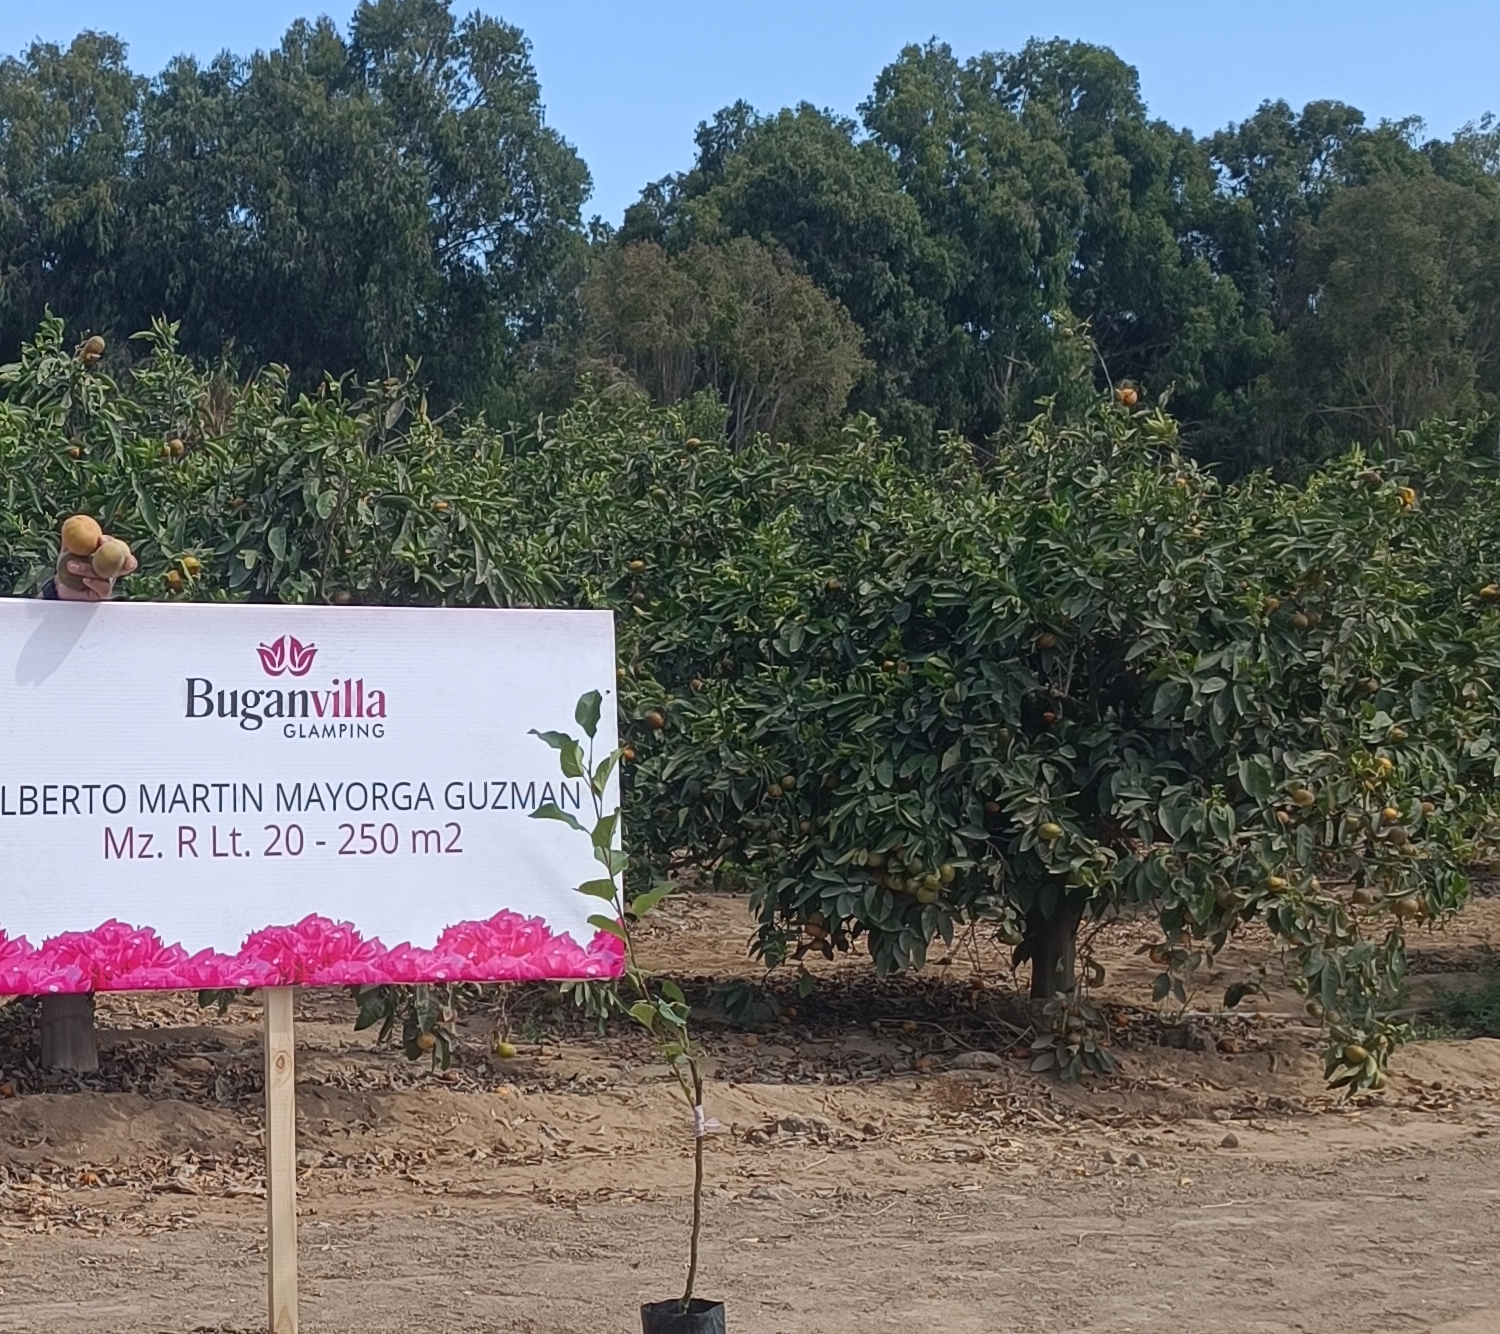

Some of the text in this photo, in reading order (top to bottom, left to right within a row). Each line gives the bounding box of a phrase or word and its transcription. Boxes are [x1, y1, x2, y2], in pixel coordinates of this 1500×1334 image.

[184, 676, 388, 731] Buganvilla
[283, 722, 386, 740] GLAMPING
[138, 782, 264, 815] MARTIN
[275, 781, 436, 813] MAYORGA
[443, 780, 581, 811] GUZMAN
[103, 825, 164, 861] Mz.
[177, 824, 200, 859] R
[211, 824, 251, 858] Lt.
[262, 823, 305, 857] 20
[337, 822, 400, 856] 250
[410, 820, 464, 855] m2
